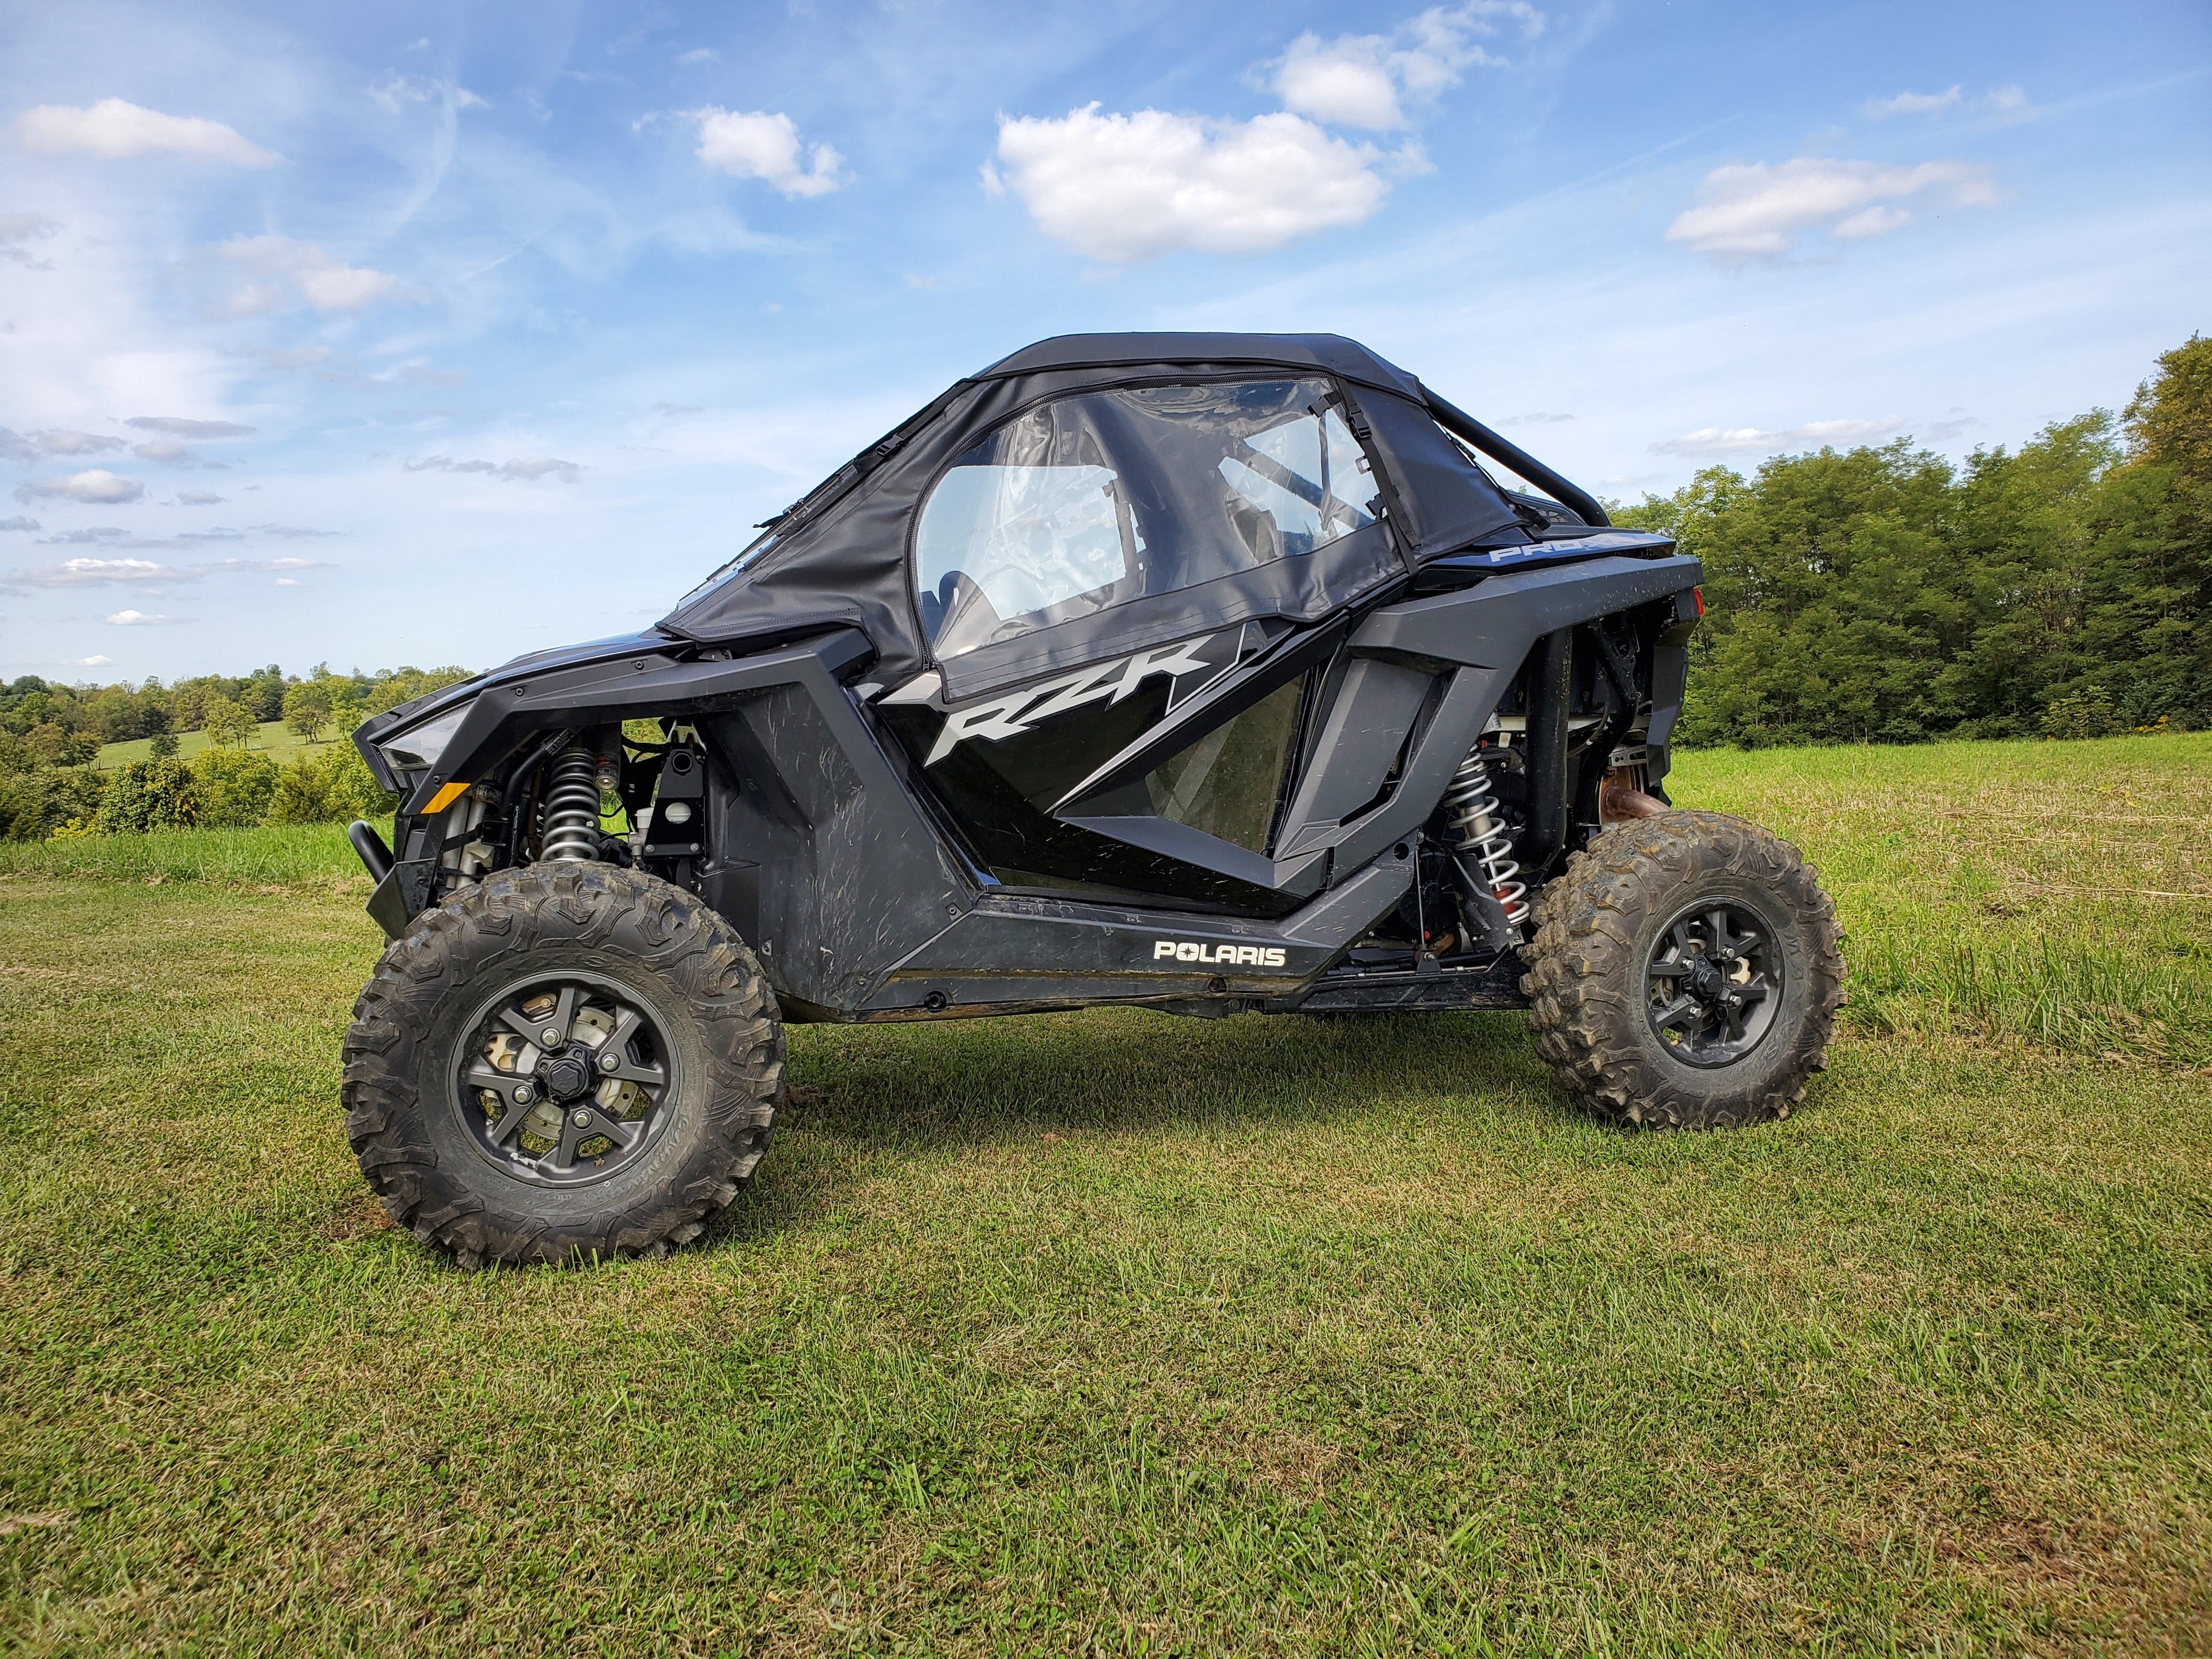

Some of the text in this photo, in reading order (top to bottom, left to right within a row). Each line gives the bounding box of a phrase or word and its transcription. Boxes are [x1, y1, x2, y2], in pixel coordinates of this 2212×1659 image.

[1489, 540, 1582, 562] PRO
[923, 634, 1214, 768] RZR
[1154, 941, 1285, 966] POLARIS
